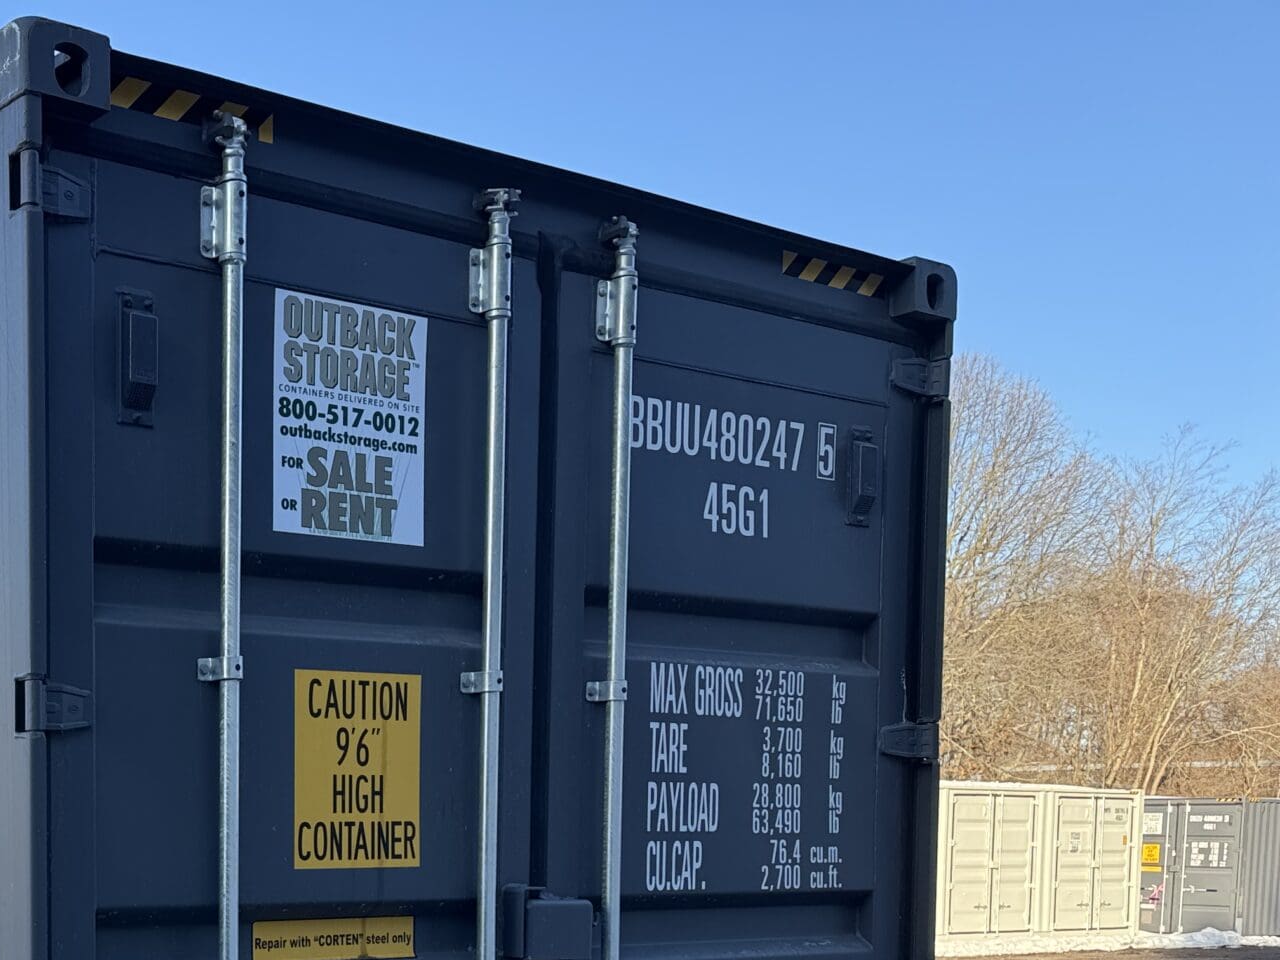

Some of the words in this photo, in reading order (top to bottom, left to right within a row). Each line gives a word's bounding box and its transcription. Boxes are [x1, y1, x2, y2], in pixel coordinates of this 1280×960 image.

[283, 295, 416, 360] OUTBACK
[283, 340, 410, 401] STORAGE
[278, 396, 420, 437] 800-517-0012
[279, 384, 335, 400] CONTAINERS
[338, 393, 384, 408] DELIVERED
[387, 402, 399, 411] ON
[402, 404, 420, 414] SITE
[280, 423, 418, 454] outbackstorage.com
[819, 425, 834, 477] 5
[281, 455, 304, 471] FOR
[306, 446, 393, 496] SALE
[281, 497, 298, 511] OR
[300, 487, 398, 537] RENT
[703, 481, 769, 539] 45G1
[308, 678, 409, 721] CAUTION
[649, 661, 688, 715] MAX
[694, 665, 744, 718] GROSS
[755, 669, 805, 697] 32,500
[831, 674, 847, 704] kg
[754, 695, 803, 722] 71,650
[831, 700, 842, 724] lb
[335, 727, 381, 767] 9'6"
[649, 722, 689, 774] TARE
[762, 726, 803, 754] 3,700
[829, 729, 844, 760] kg
[761, 752, 802, 780] 8,160
[829, 755, 840, 779] lb
[332, 774, 384, 814] HIGH
[646, 781, 719, 832] PAYLOAD
[752, 783, 801, 810] 28,800
[829, 785, 843, 814] kg
[297, 820, 416, 861] CONTAINER
[751, 808, 801, 835] 63,490
[828, 811, 840, 834] lb
[770, 839, 802, 864] 76.4
[761, 865, 801, 891] 2,700
[254, 937, 287, 952] Repair
[289, 935, 311, 948] with
[366, 932, 389, 945] steel
[392, 931, 412, 946] only
